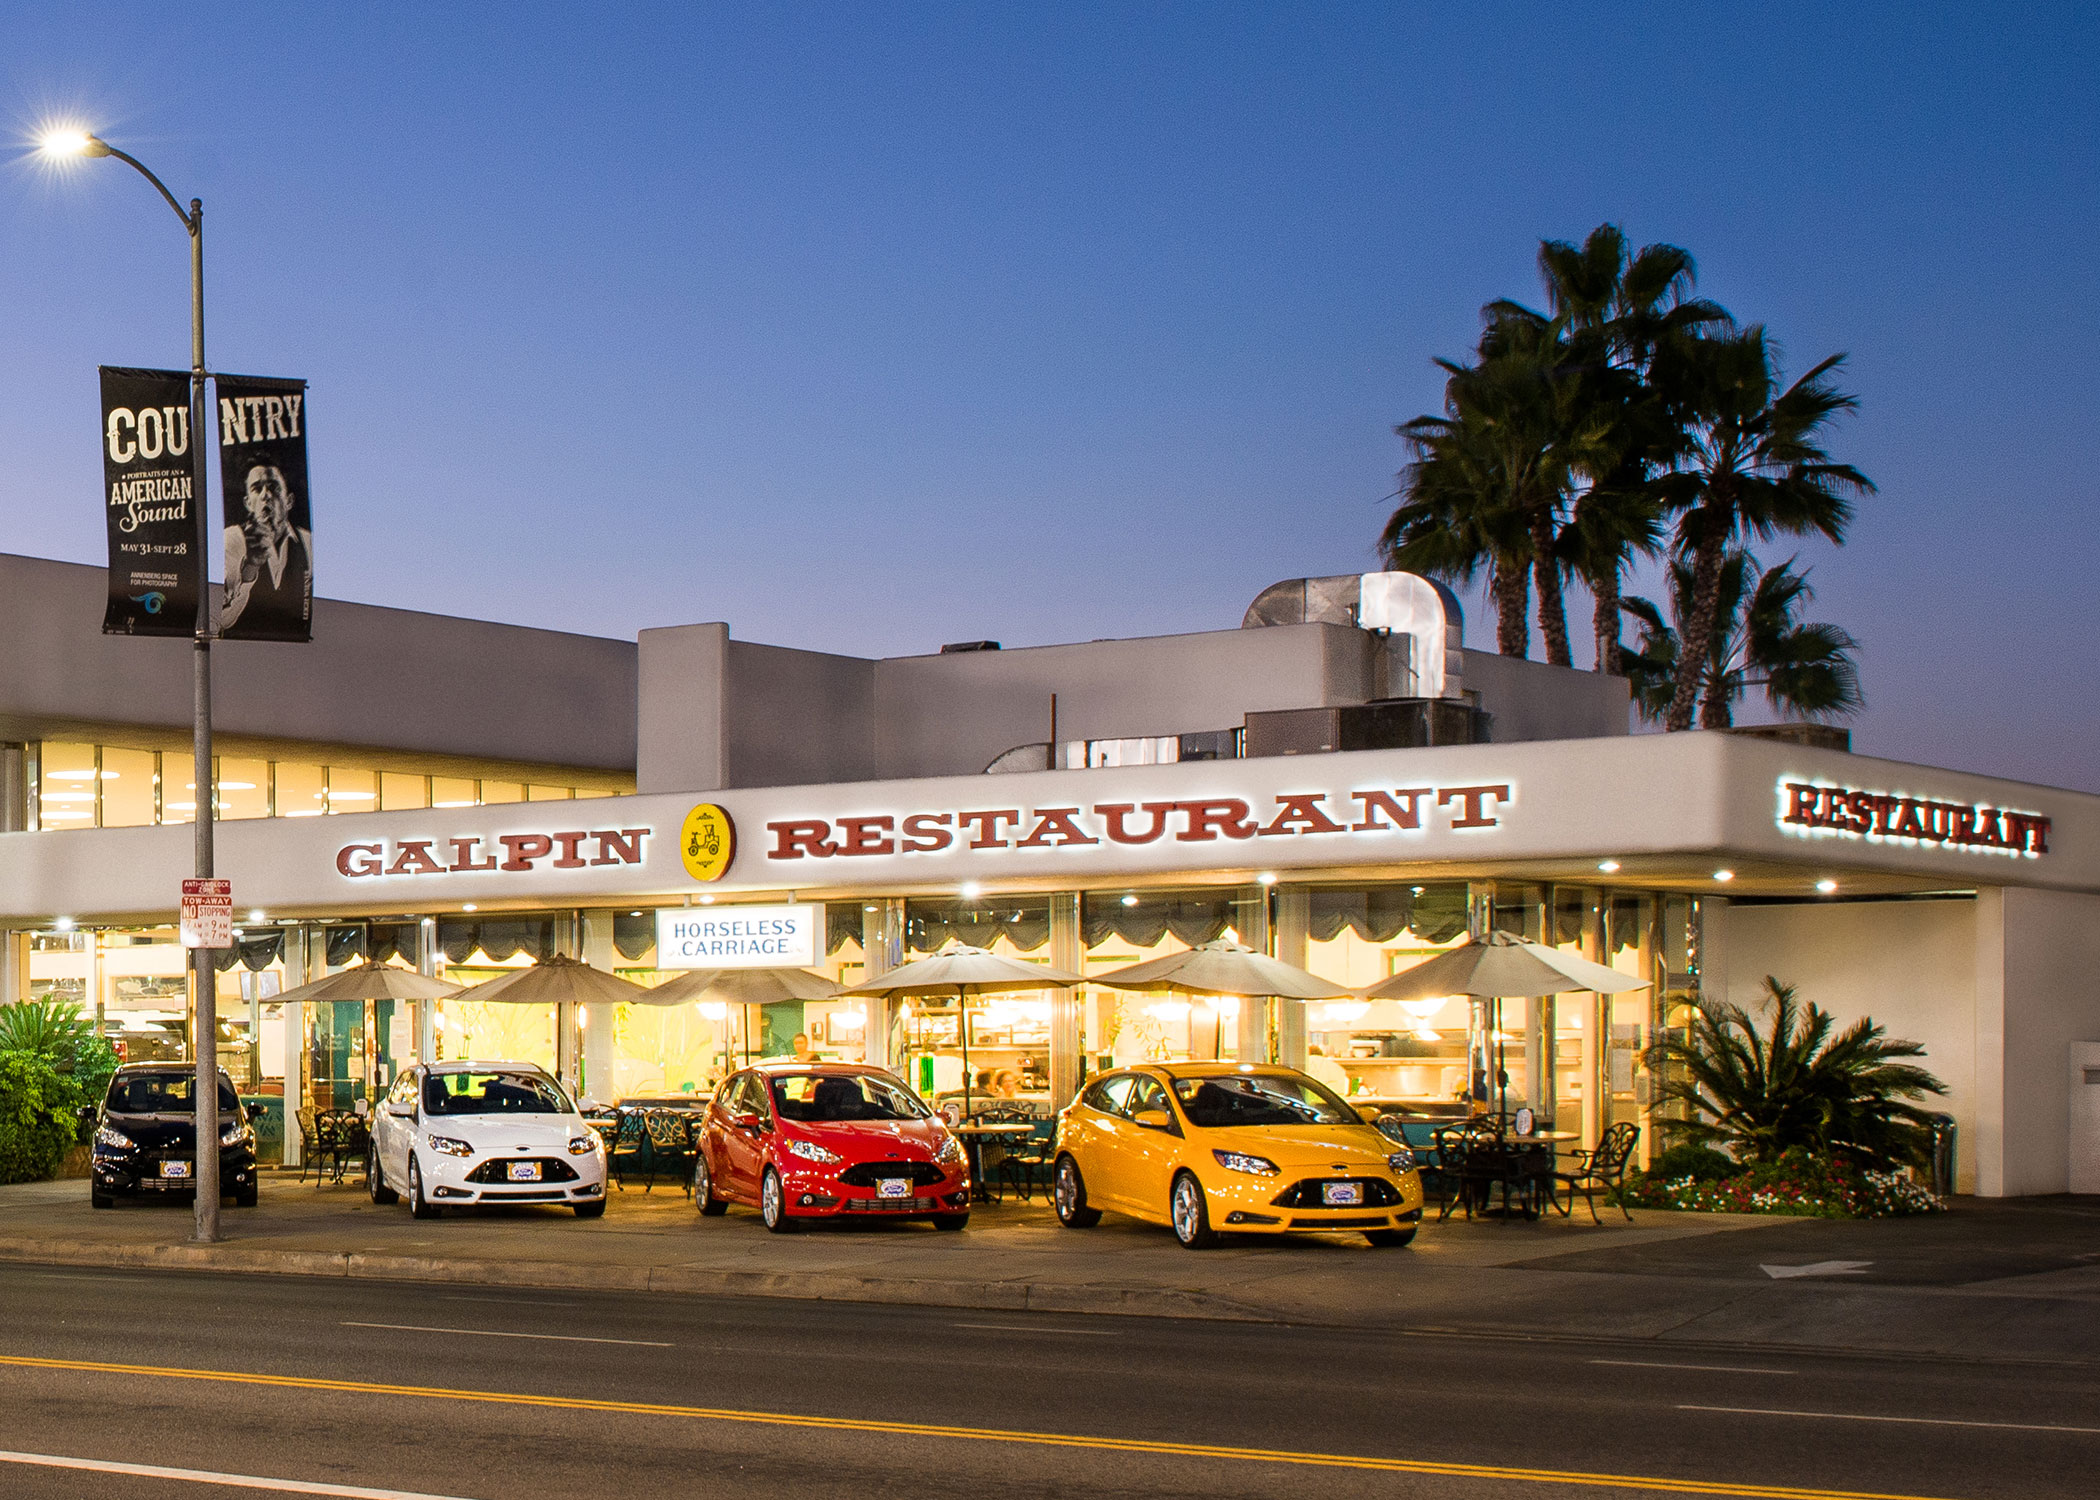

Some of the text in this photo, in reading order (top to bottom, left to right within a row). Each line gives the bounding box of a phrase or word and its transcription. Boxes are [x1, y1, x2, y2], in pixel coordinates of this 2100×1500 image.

[220, 394, 302, 446] NTRY
[107, 406, 188, 464] COU
[127, 471, 160, 479] PORTRAITS
[110, 476, 192, 506] AMERICAN
[119, 500, 187, 533] Sound
[121, 543, 139, 552] MAY
[174, 542, 187, 555] 28
[130, 578, 178, 588] FOR PHOTOGRAPHY
[161, 573, 178, 581] SPACE
[1784, 783, 2051, 854] RESTAURANT
[336, 785, 1511, 877] GALPIN RESTAURANT
[183, 905, 231, 918] NO STOPPING
[211, 919, 217, 929] 9
[674, 919, 797, 938] HORSELESS
[211, 930, 217, 939] 7
[682, 938, 789, 956] CARRIAGE
